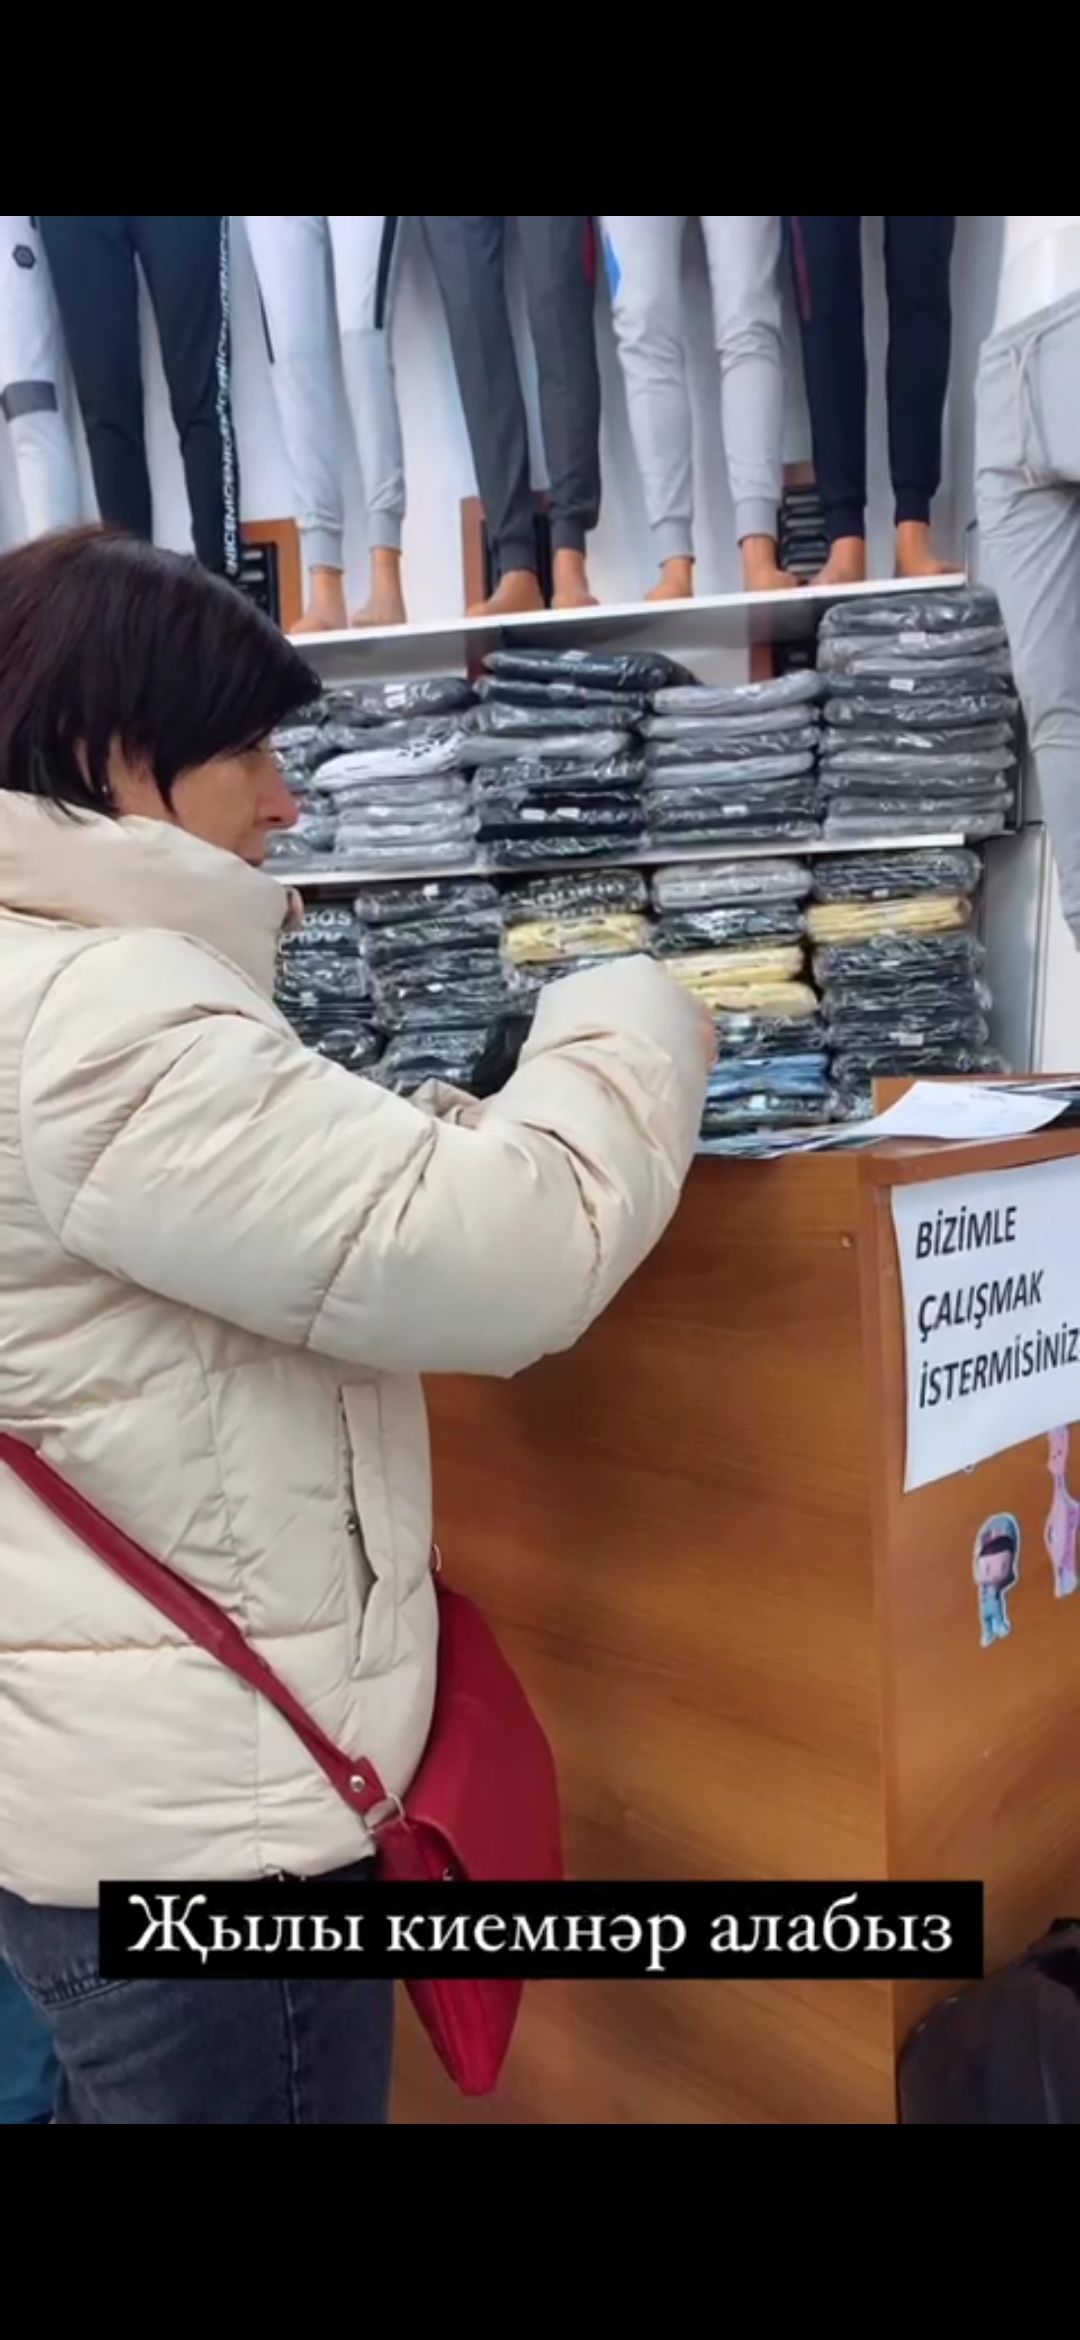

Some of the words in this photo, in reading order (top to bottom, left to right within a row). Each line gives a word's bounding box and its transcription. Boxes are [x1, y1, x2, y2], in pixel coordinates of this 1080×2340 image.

[916, 1205, 1018, 1260] BİZİMLE
[918, 1269, 1044, 1343] ÇALIŞMAK
[919, 1321, 1080, 1409] İSTERMİSİNİZ
